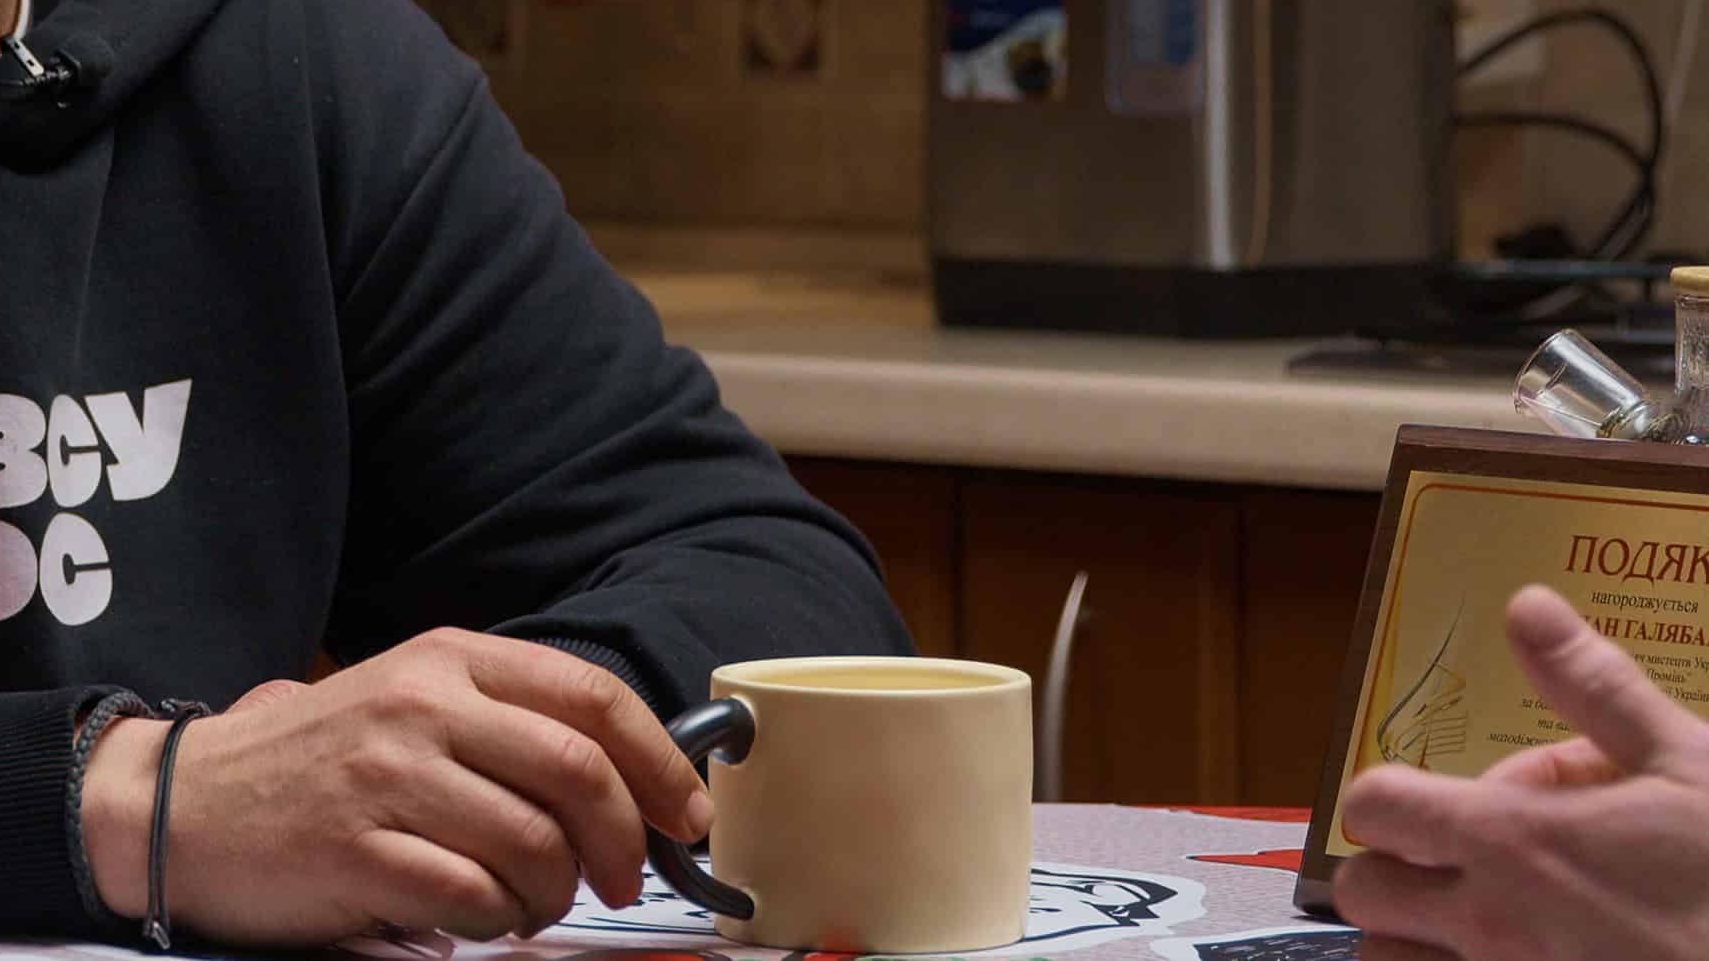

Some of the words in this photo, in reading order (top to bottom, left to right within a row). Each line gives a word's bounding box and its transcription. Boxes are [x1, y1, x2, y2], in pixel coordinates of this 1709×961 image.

[1564, 534, 1709, 587] ПОДЯК
[1591, 591, 1699, 614] нагороджується
[1580, 615, 1620, 638] АН
[1625, 620, 1709, 647] ГАЛЯБА
